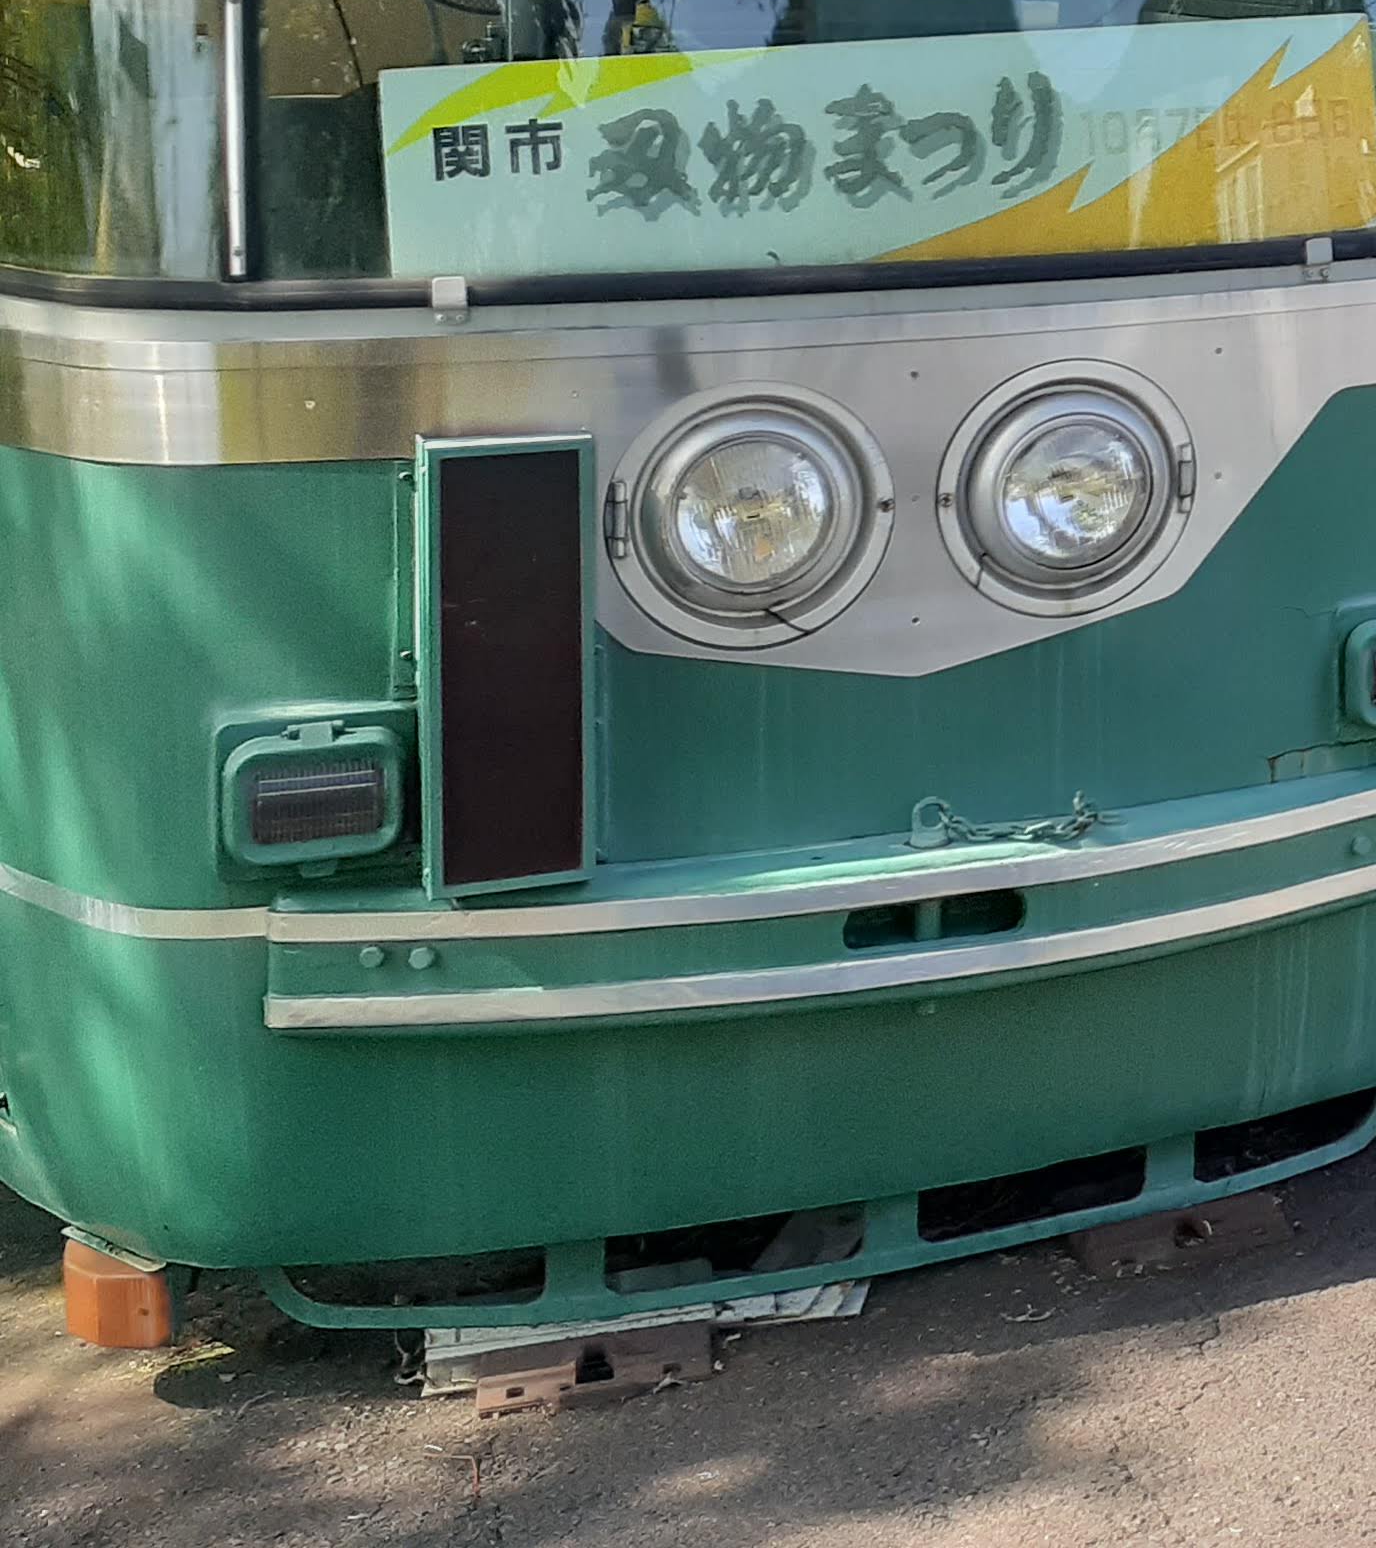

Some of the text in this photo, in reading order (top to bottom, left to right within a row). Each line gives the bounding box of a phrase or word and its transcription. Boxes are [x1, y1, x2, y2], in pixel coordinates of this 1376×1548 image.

[432, 118, 563, 181] 関市
[586, 71, 1063, 222] 刃物まつり
